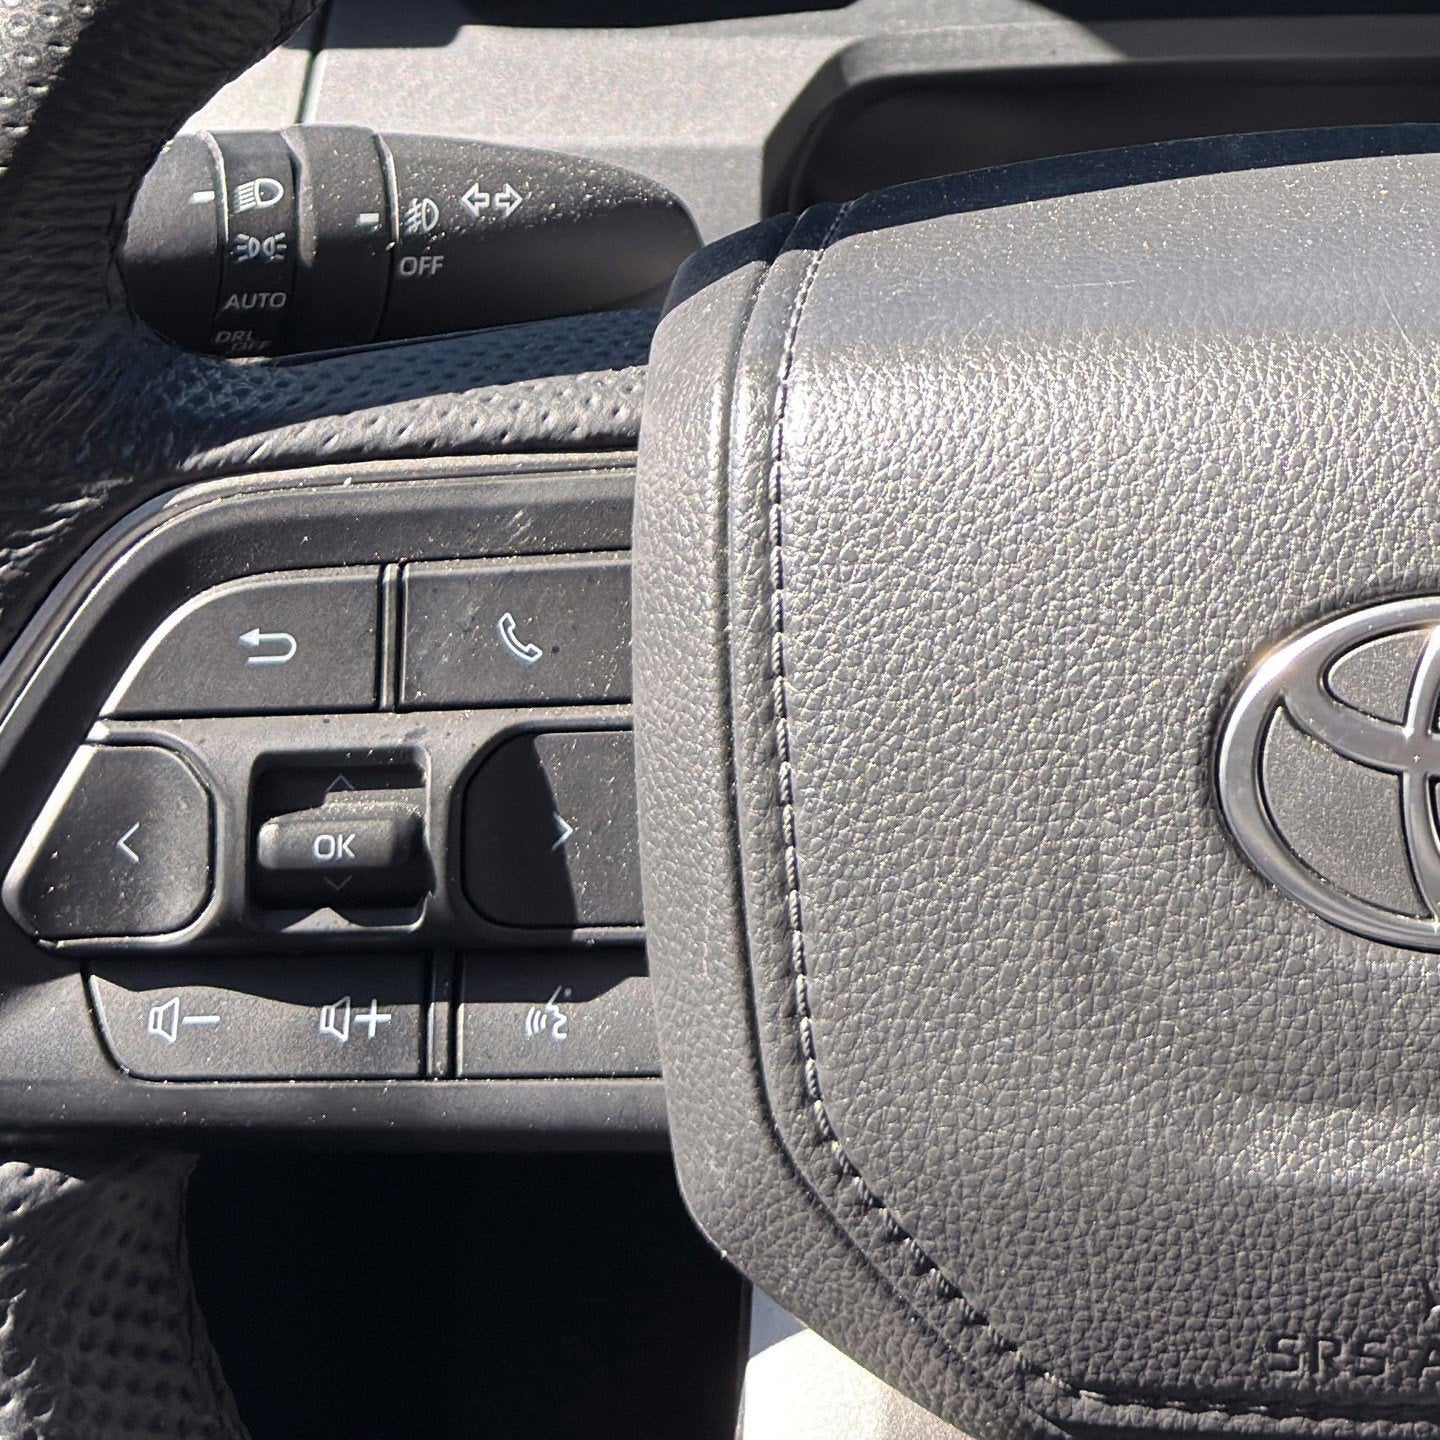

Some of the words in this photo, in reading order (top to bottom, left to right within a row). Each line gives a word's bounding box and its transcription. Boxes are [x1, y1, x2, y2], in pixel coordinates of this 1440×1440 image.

[399, 254, 444, 277] OFF
[224, 291, 287, 310] AUTO
[313, 834, 356, 859] OK
[1264, 1334, 1389, 1380] SRS
